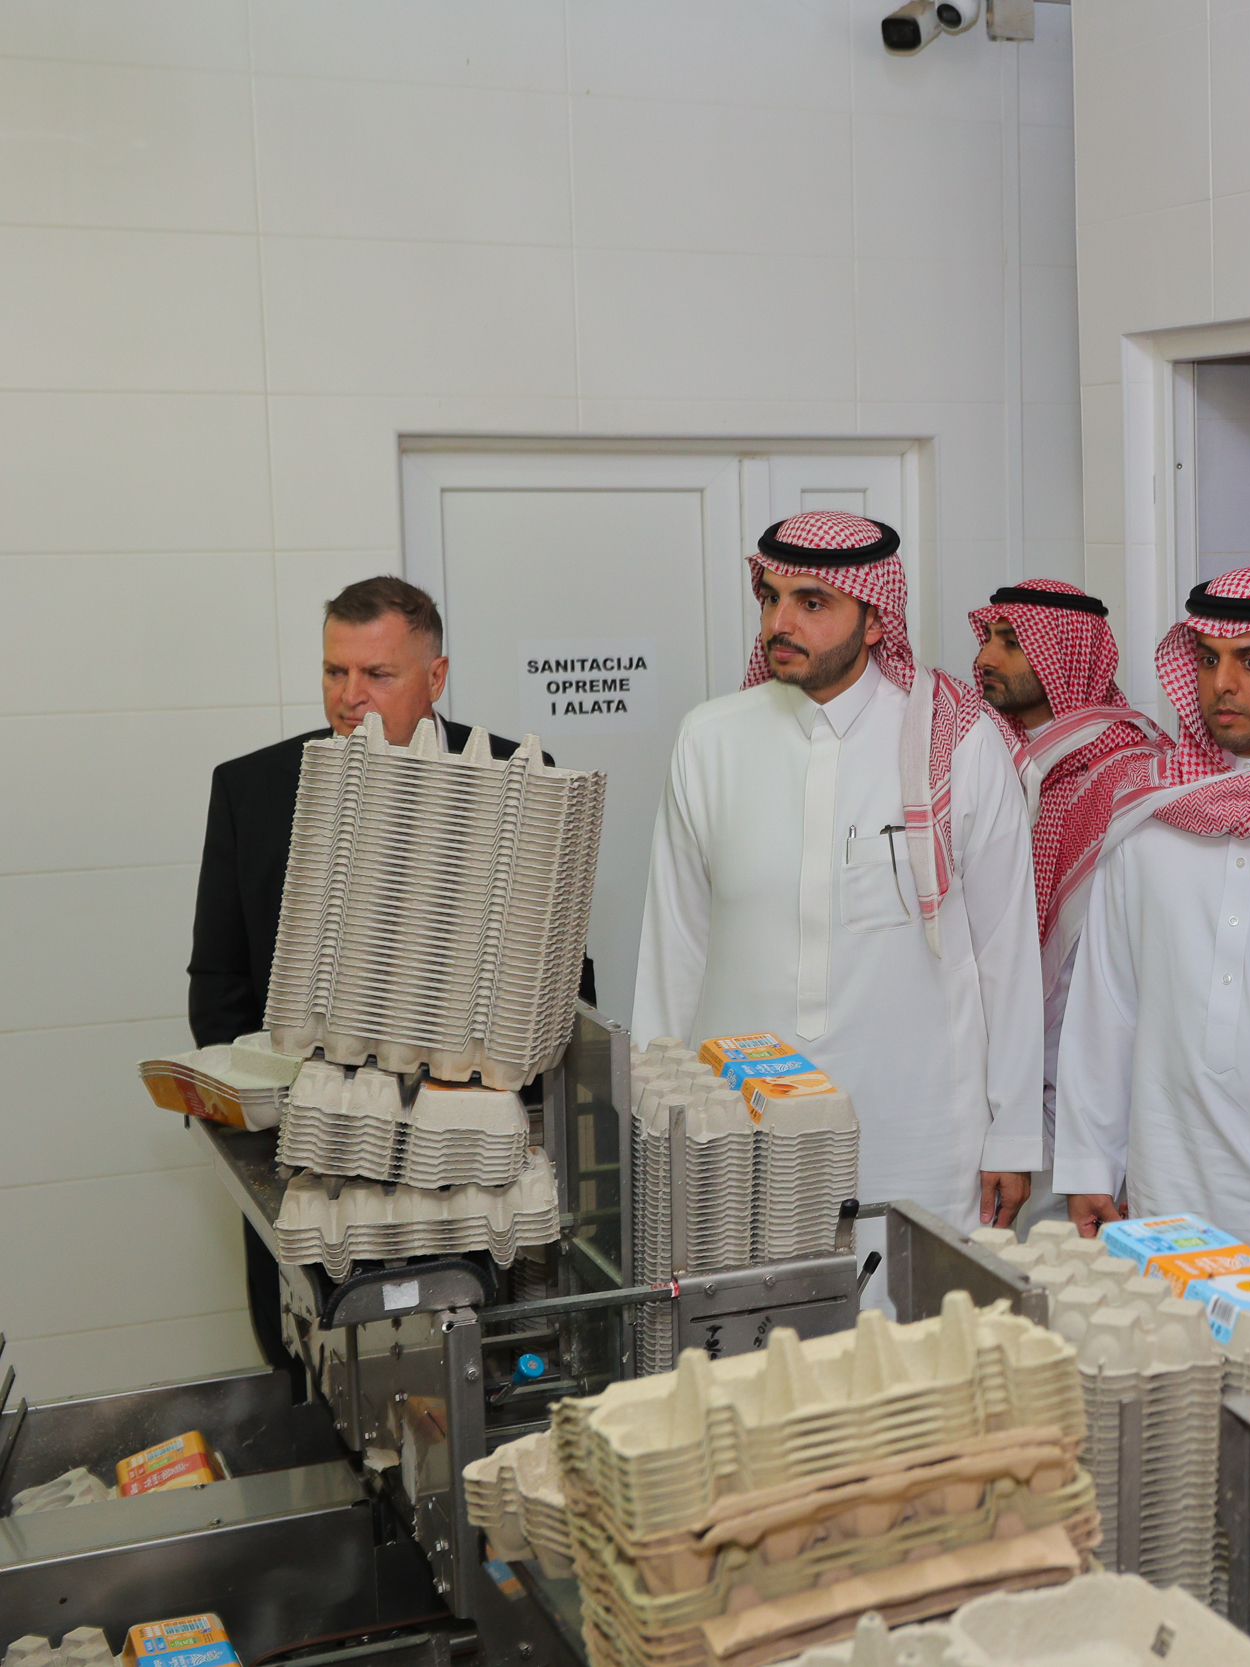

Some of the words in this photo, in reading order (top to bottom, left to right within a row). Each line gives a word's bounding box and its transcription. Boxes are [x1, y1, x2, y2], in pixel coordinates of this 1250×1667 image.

[527, 656, 648, 674] SANITACIJA
[546, 678, 630, 694] OPREME
[551, 702, 557, 716] I
[564, 699, 628, 715] ALATA
